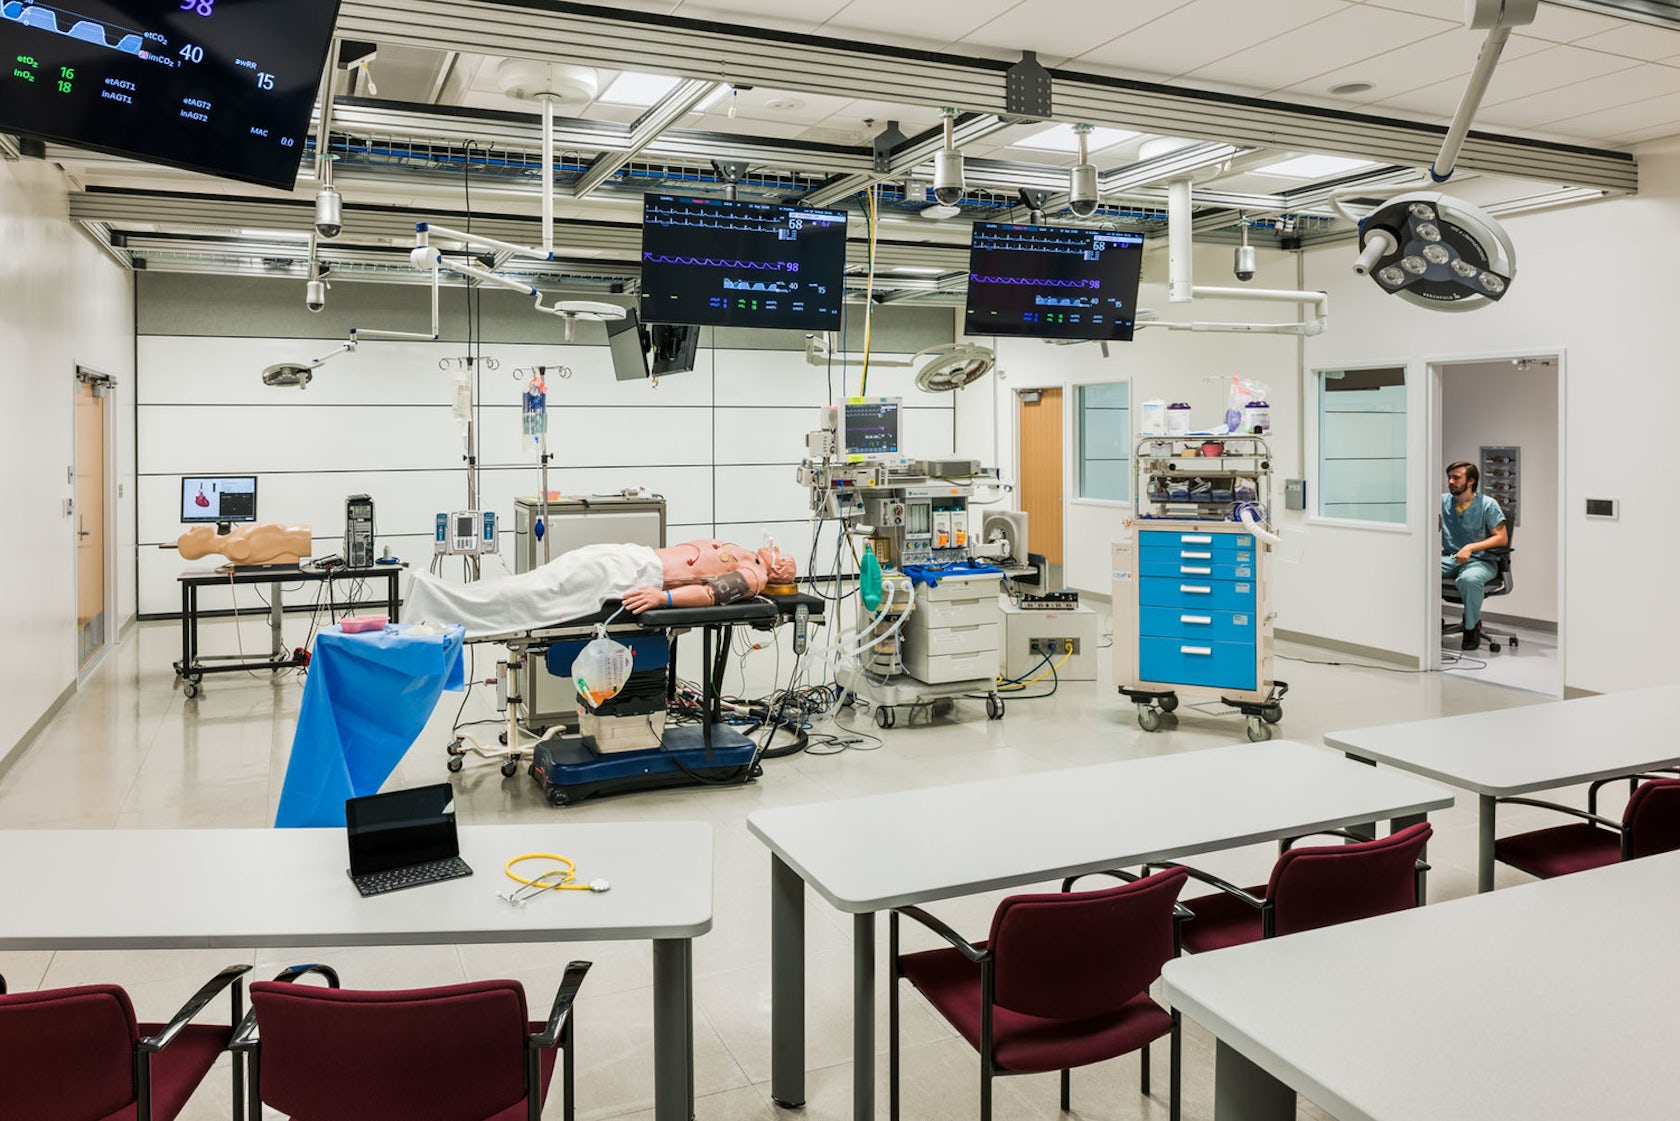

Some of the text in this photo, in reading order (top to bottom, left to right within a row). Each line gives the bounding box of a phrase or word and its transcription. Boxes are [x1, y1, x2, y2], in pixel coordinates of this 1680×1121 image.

[179, 43, 204, 63] 40
[234, 58, 258, 70] awRR
[60, 66, 75, 80] 16
[57, 80, 72, 94] 18
[104, 77, 136, 92] etAGT1
[257, 72, 275, 91] 15
[183, 98, 212, 110] etAGT2
[250, 126, 269, 137] MAC
[789, 218, 803, 230] 68
[1092, 241, 1106, 251] 68
[786, 261, 799, 272] 98
[789, 282, 799, 290] 40
[1089, 280, 1101, 289] 98
